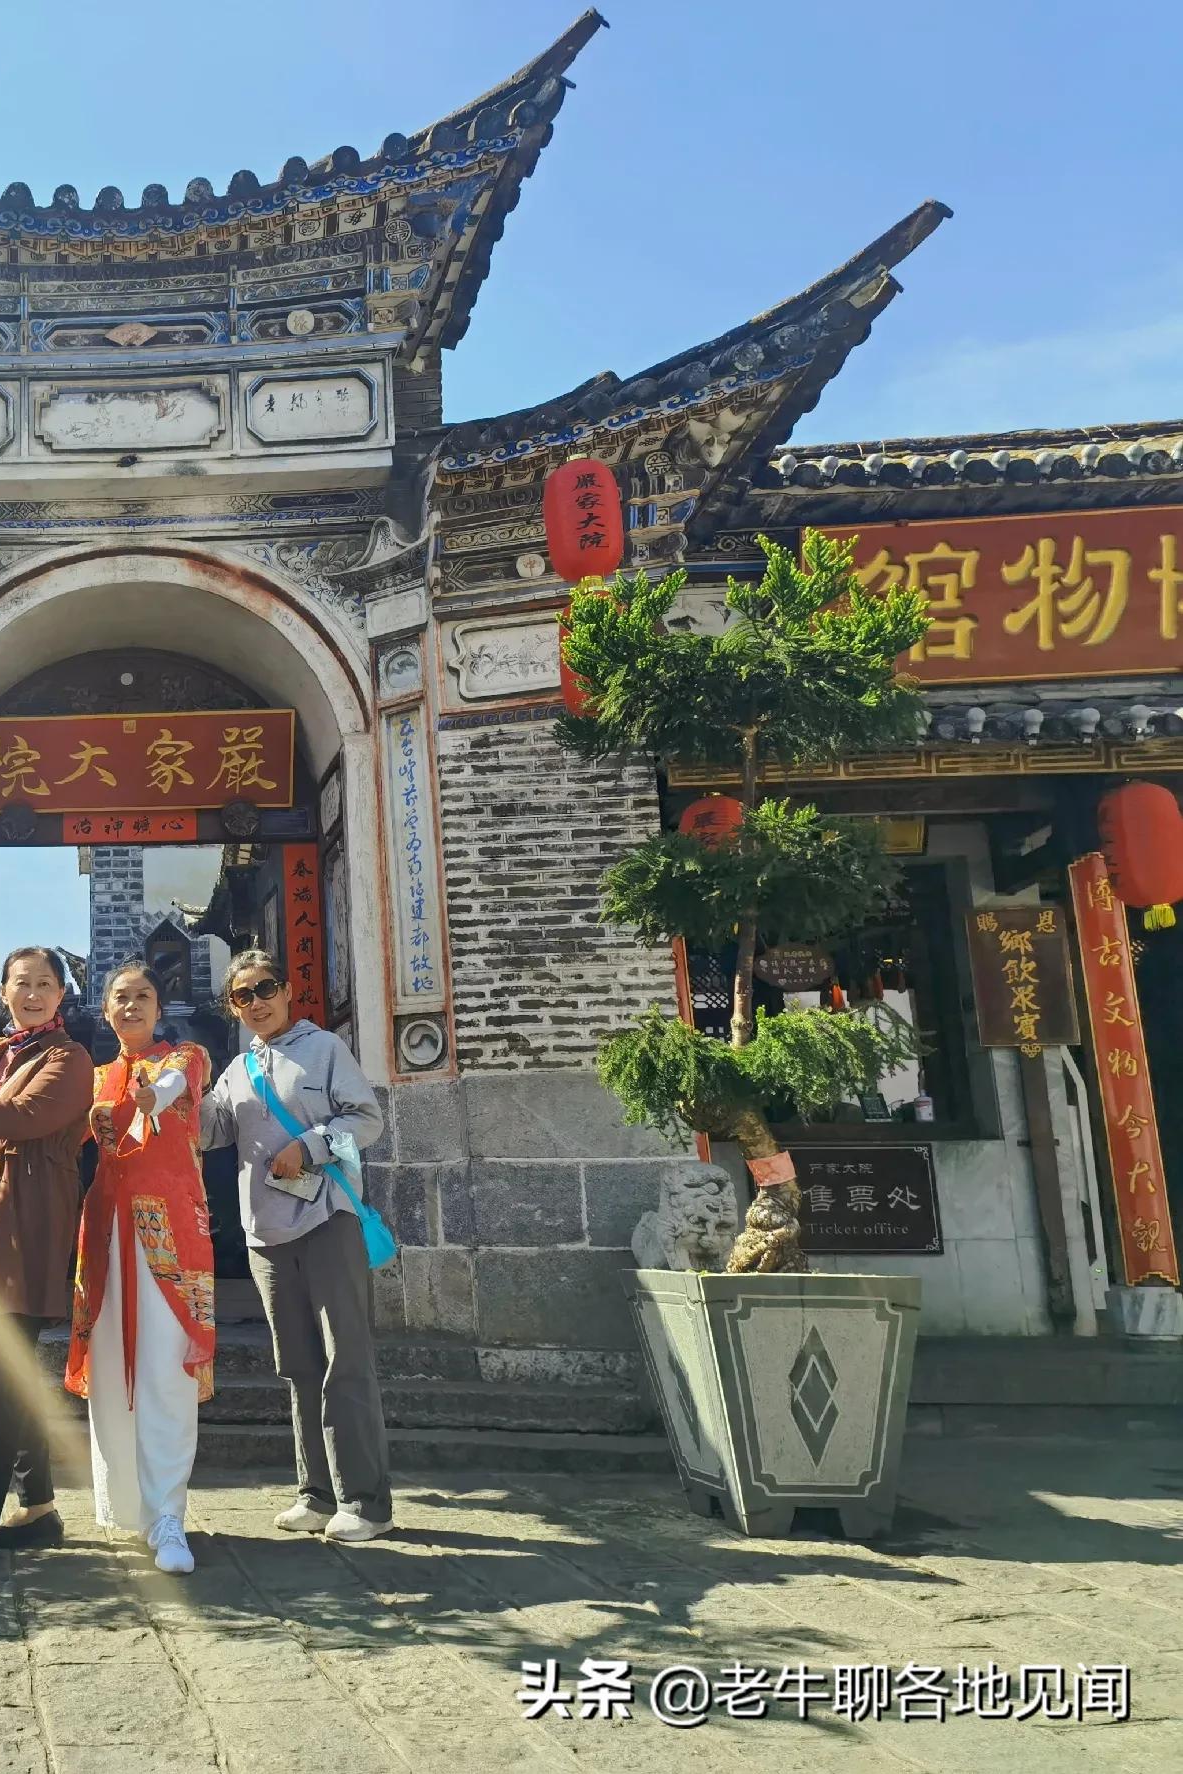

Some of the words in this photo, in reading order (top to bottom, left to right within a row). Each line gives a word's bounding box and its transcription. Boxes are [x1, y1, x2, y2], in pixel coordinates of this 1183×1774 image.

[573, 472, 610, 550] 嚴家大院
[292, 858, 319, 1024] 春滿人間百花
[802, 1184, 922, 1213] 售票处
[807, 1223, 858, 1235] Ticket
[863, 1222, 909, 1235] office
